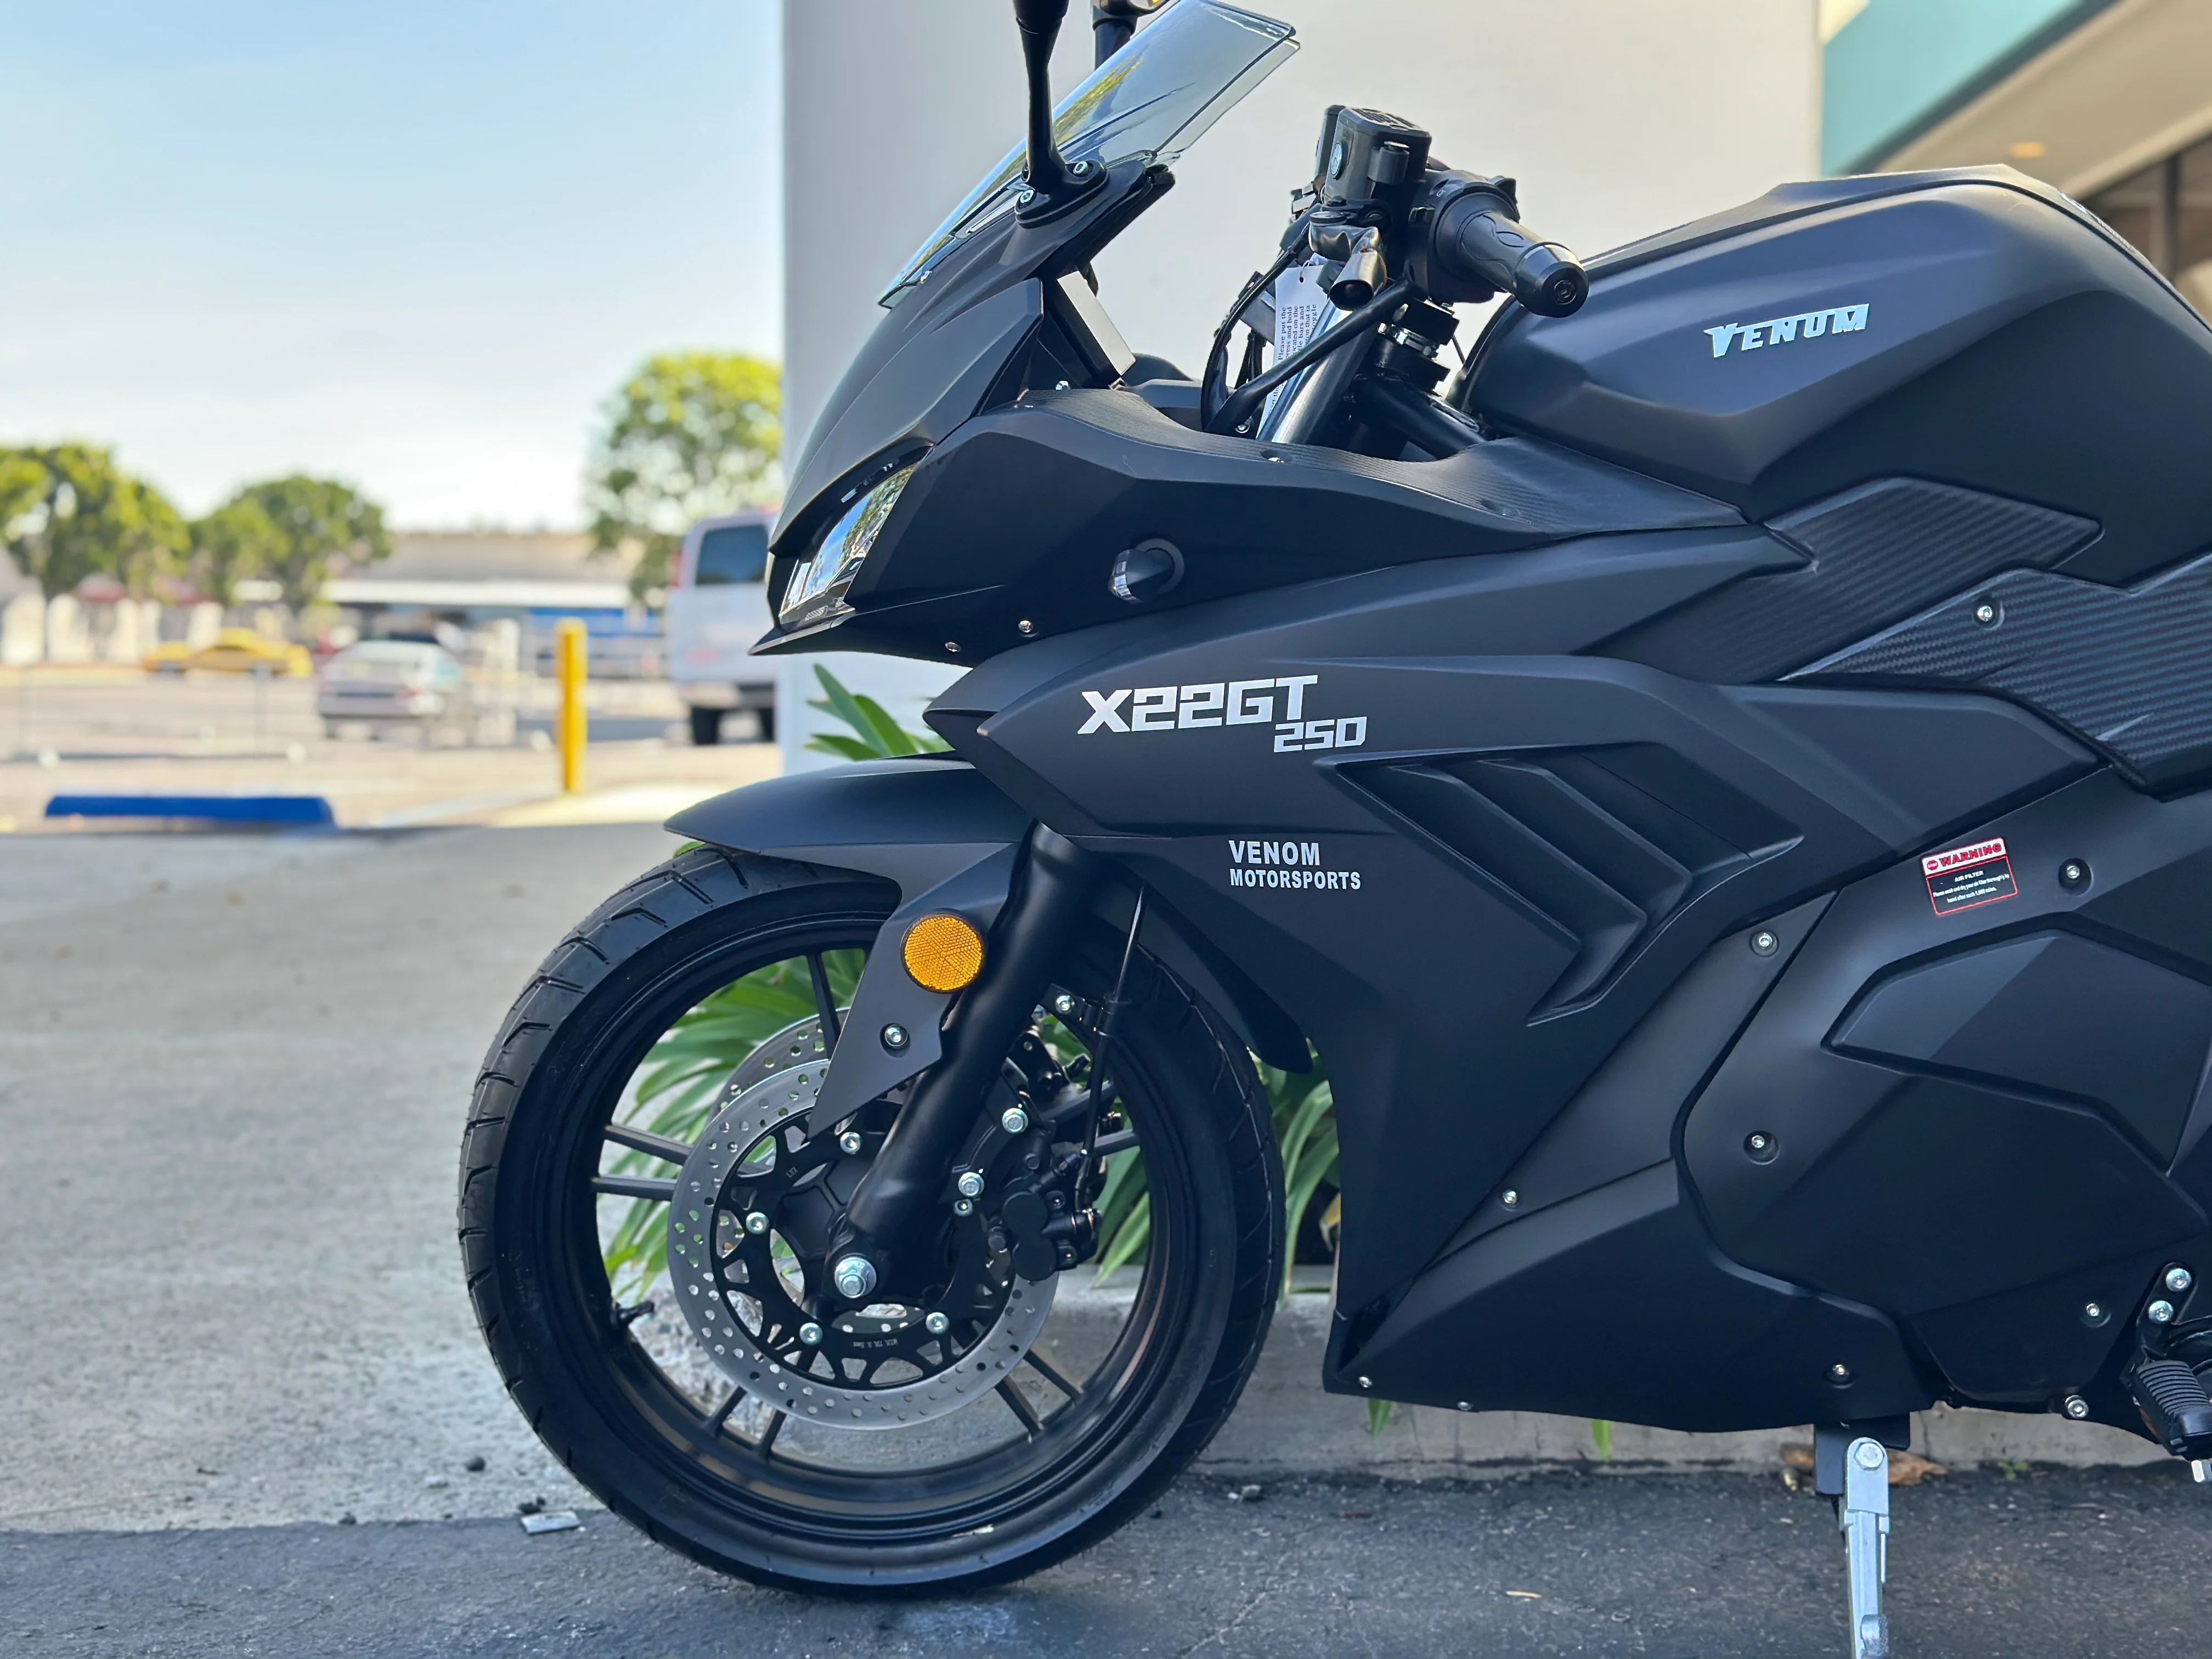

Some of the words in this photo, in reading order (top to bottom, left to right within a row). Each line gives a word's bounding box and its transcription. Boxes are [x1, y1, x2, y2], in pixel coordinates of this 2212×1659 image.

[1293, 319, 1298, 329] on
[1703, 303, 1869, 358] VENOM
[1077, 675, 1318, 734] X22GT
[1273, 716, 1367, 752] 250
[1228, 840, 1320, 866] VENOM
[1939, 843, 2002, 867] WARNING
[1229, 868, 1361, 890] MOTORSPORTS
[1965, 871, 1984, 879] FILTER
